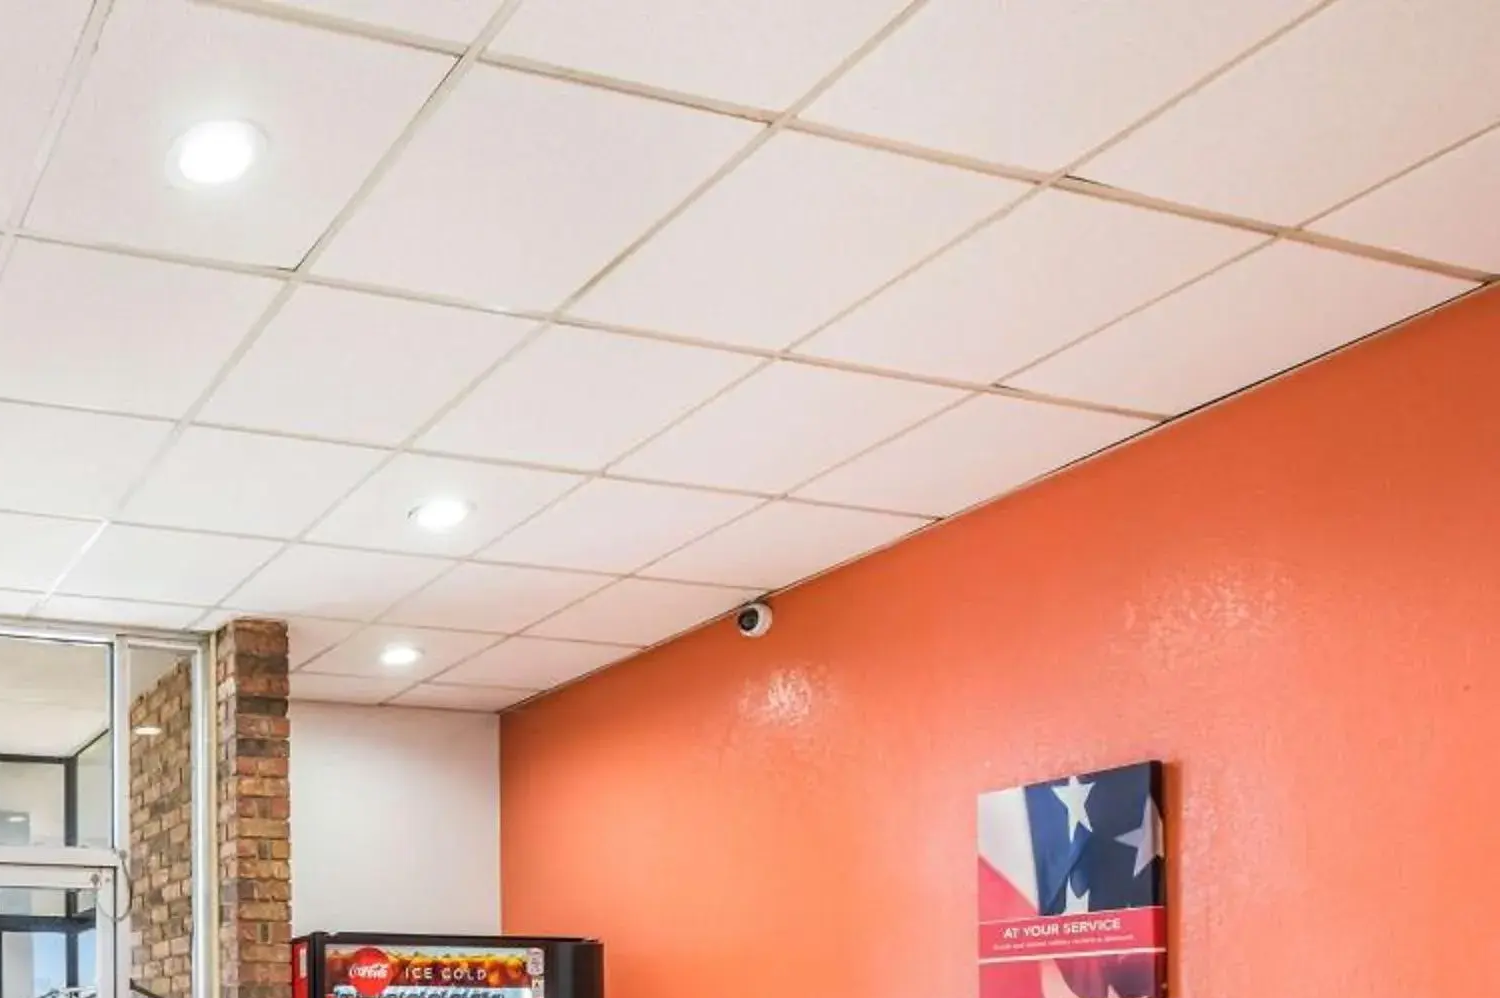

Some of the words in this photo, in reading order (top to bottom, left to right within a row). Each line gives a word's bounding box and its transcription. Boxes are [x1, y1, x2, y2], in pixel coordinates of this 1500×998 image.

[1003, 927, 1019, 939] AT
[1023, 923, 1059, 937] YOUR
[1063, 918, 1121, 934] SERVICE
[405, 967, 433, 979] ICE
[441, 967, 487, 981] COLD
